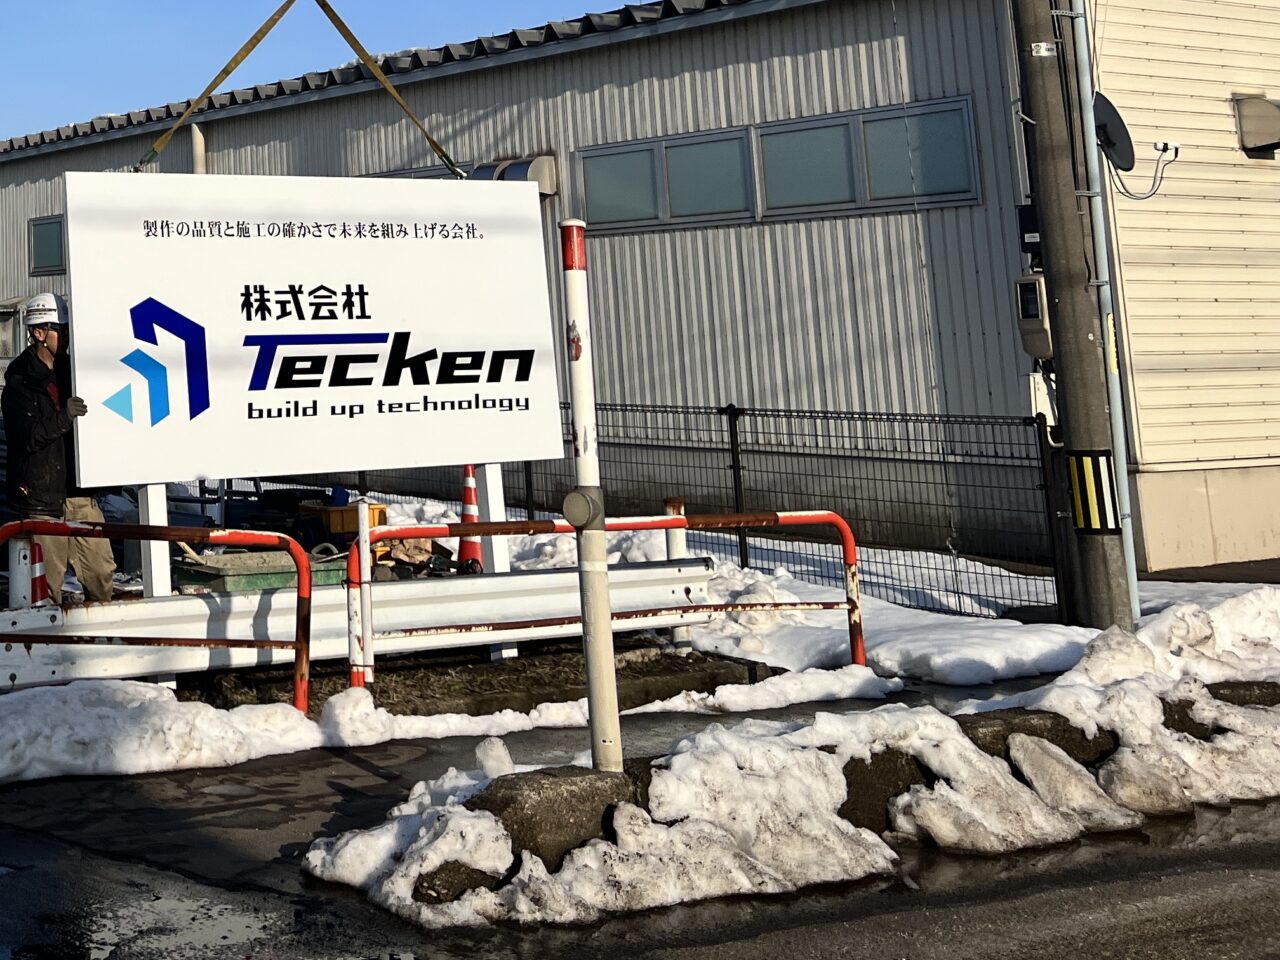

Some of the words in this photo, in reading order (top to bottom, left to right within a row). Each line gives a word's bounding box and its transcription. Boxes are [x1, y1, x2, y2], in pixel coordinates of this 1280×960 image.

[143, 219, 485, 240] 製作の品質と施工の確かさで未来を組み上げる会社。
[240, 284, 372, 322] 株式会社
[242, 331, 535, 391] Tecken
[247, 399, 318, 420] build
[330, 404, 364, 419] up
[377, 394, 530, 413] technology
